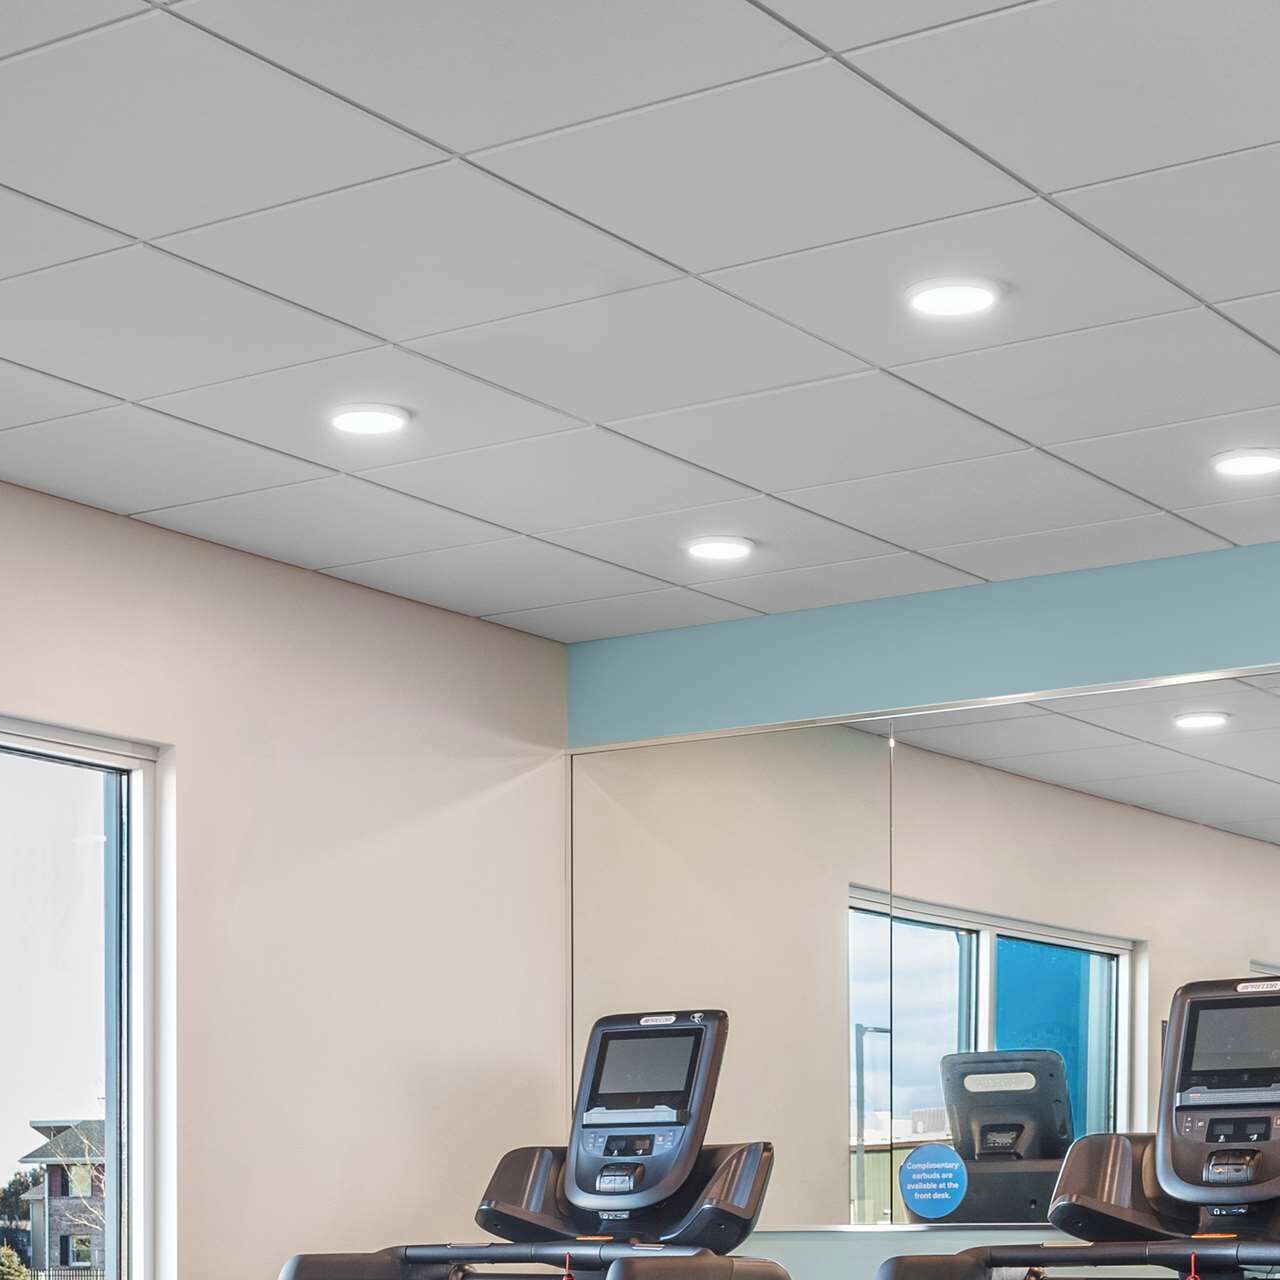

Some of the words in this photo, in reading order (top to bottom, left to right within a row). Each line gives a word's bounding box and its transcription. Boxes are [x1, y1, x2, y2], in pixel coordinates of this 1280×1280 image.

[906, 1161, 960, 1170] Complimentary
[906, 1182, 937, 1190] available
[947, 1182, 959, 1190] the
[932, 1191, 951, 1199] desk.
